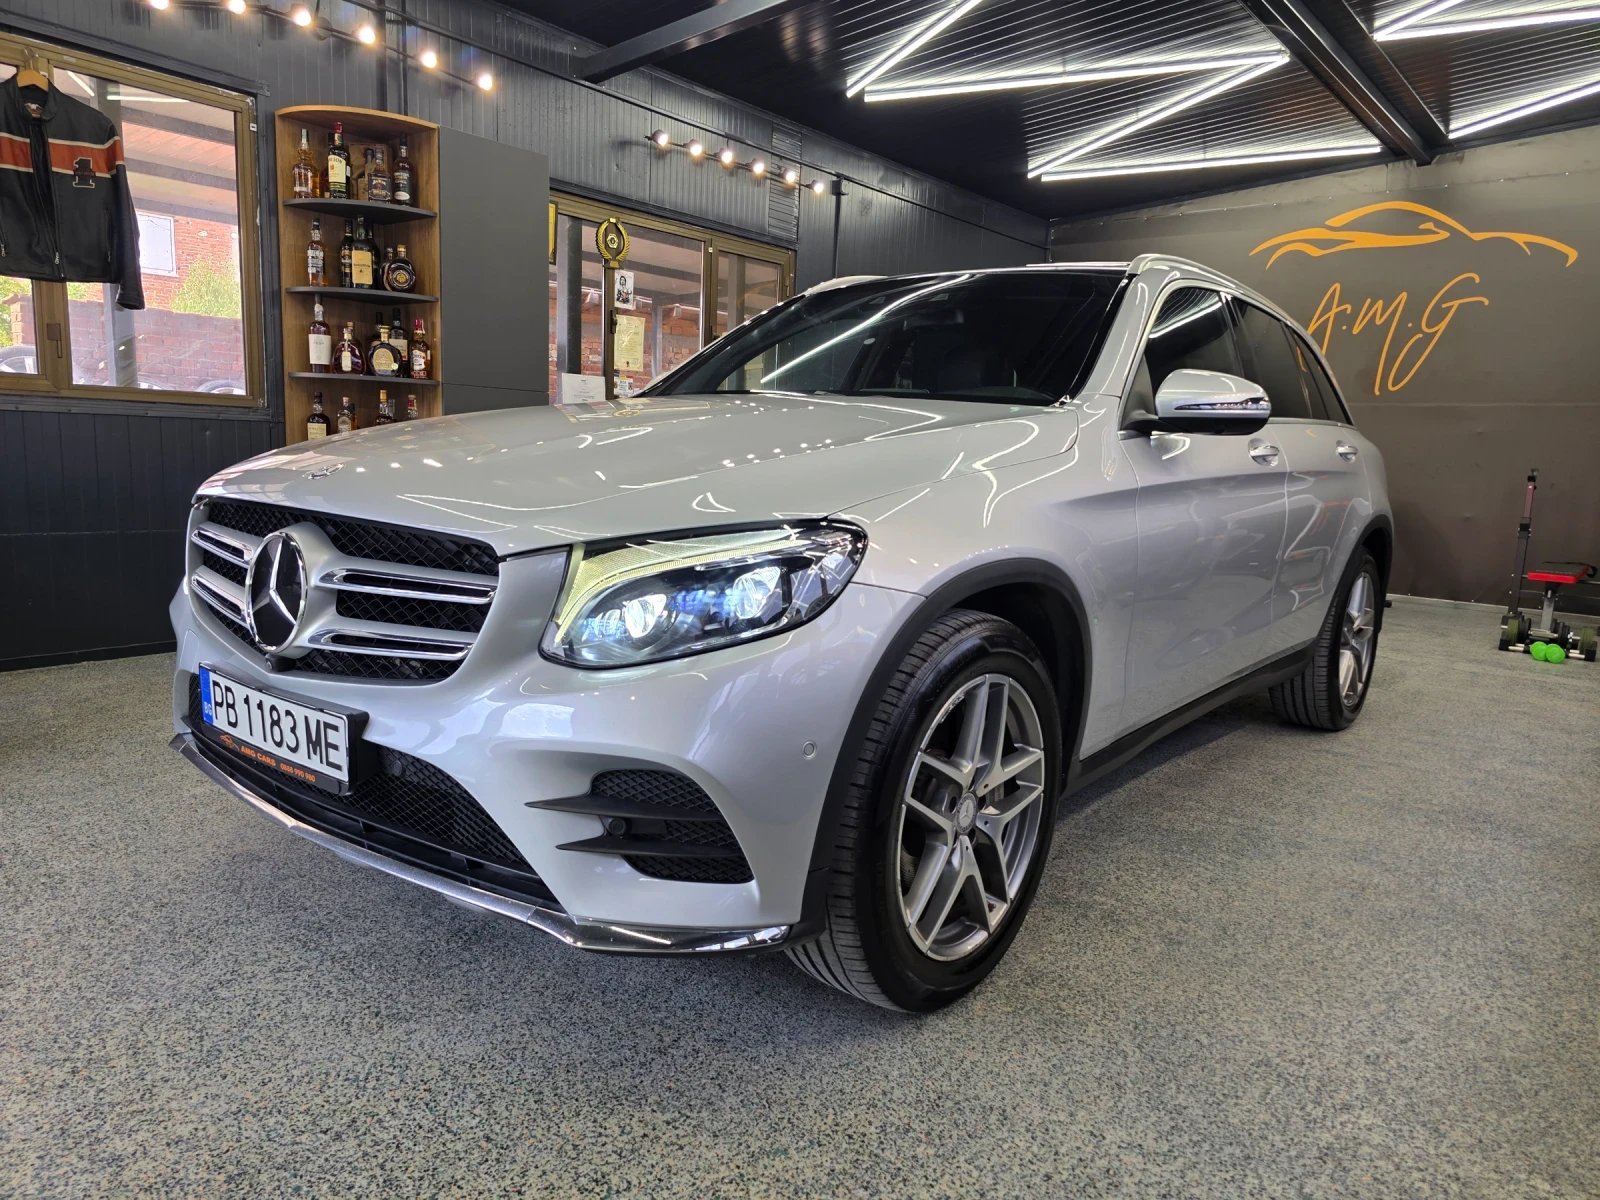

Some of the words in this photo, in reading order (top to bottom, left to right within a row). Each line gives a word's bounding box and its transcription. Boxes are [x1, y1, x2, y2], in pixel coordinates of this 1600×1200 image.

[204, 701, 213, 716] BG
[212, 679, 239, 729] PB
[243, 693, 300, 754] 1183
[304, 715, 343, 772] ME
[240, 745, 255, 757] AMG
[256, 752, 276, 766] CARS
